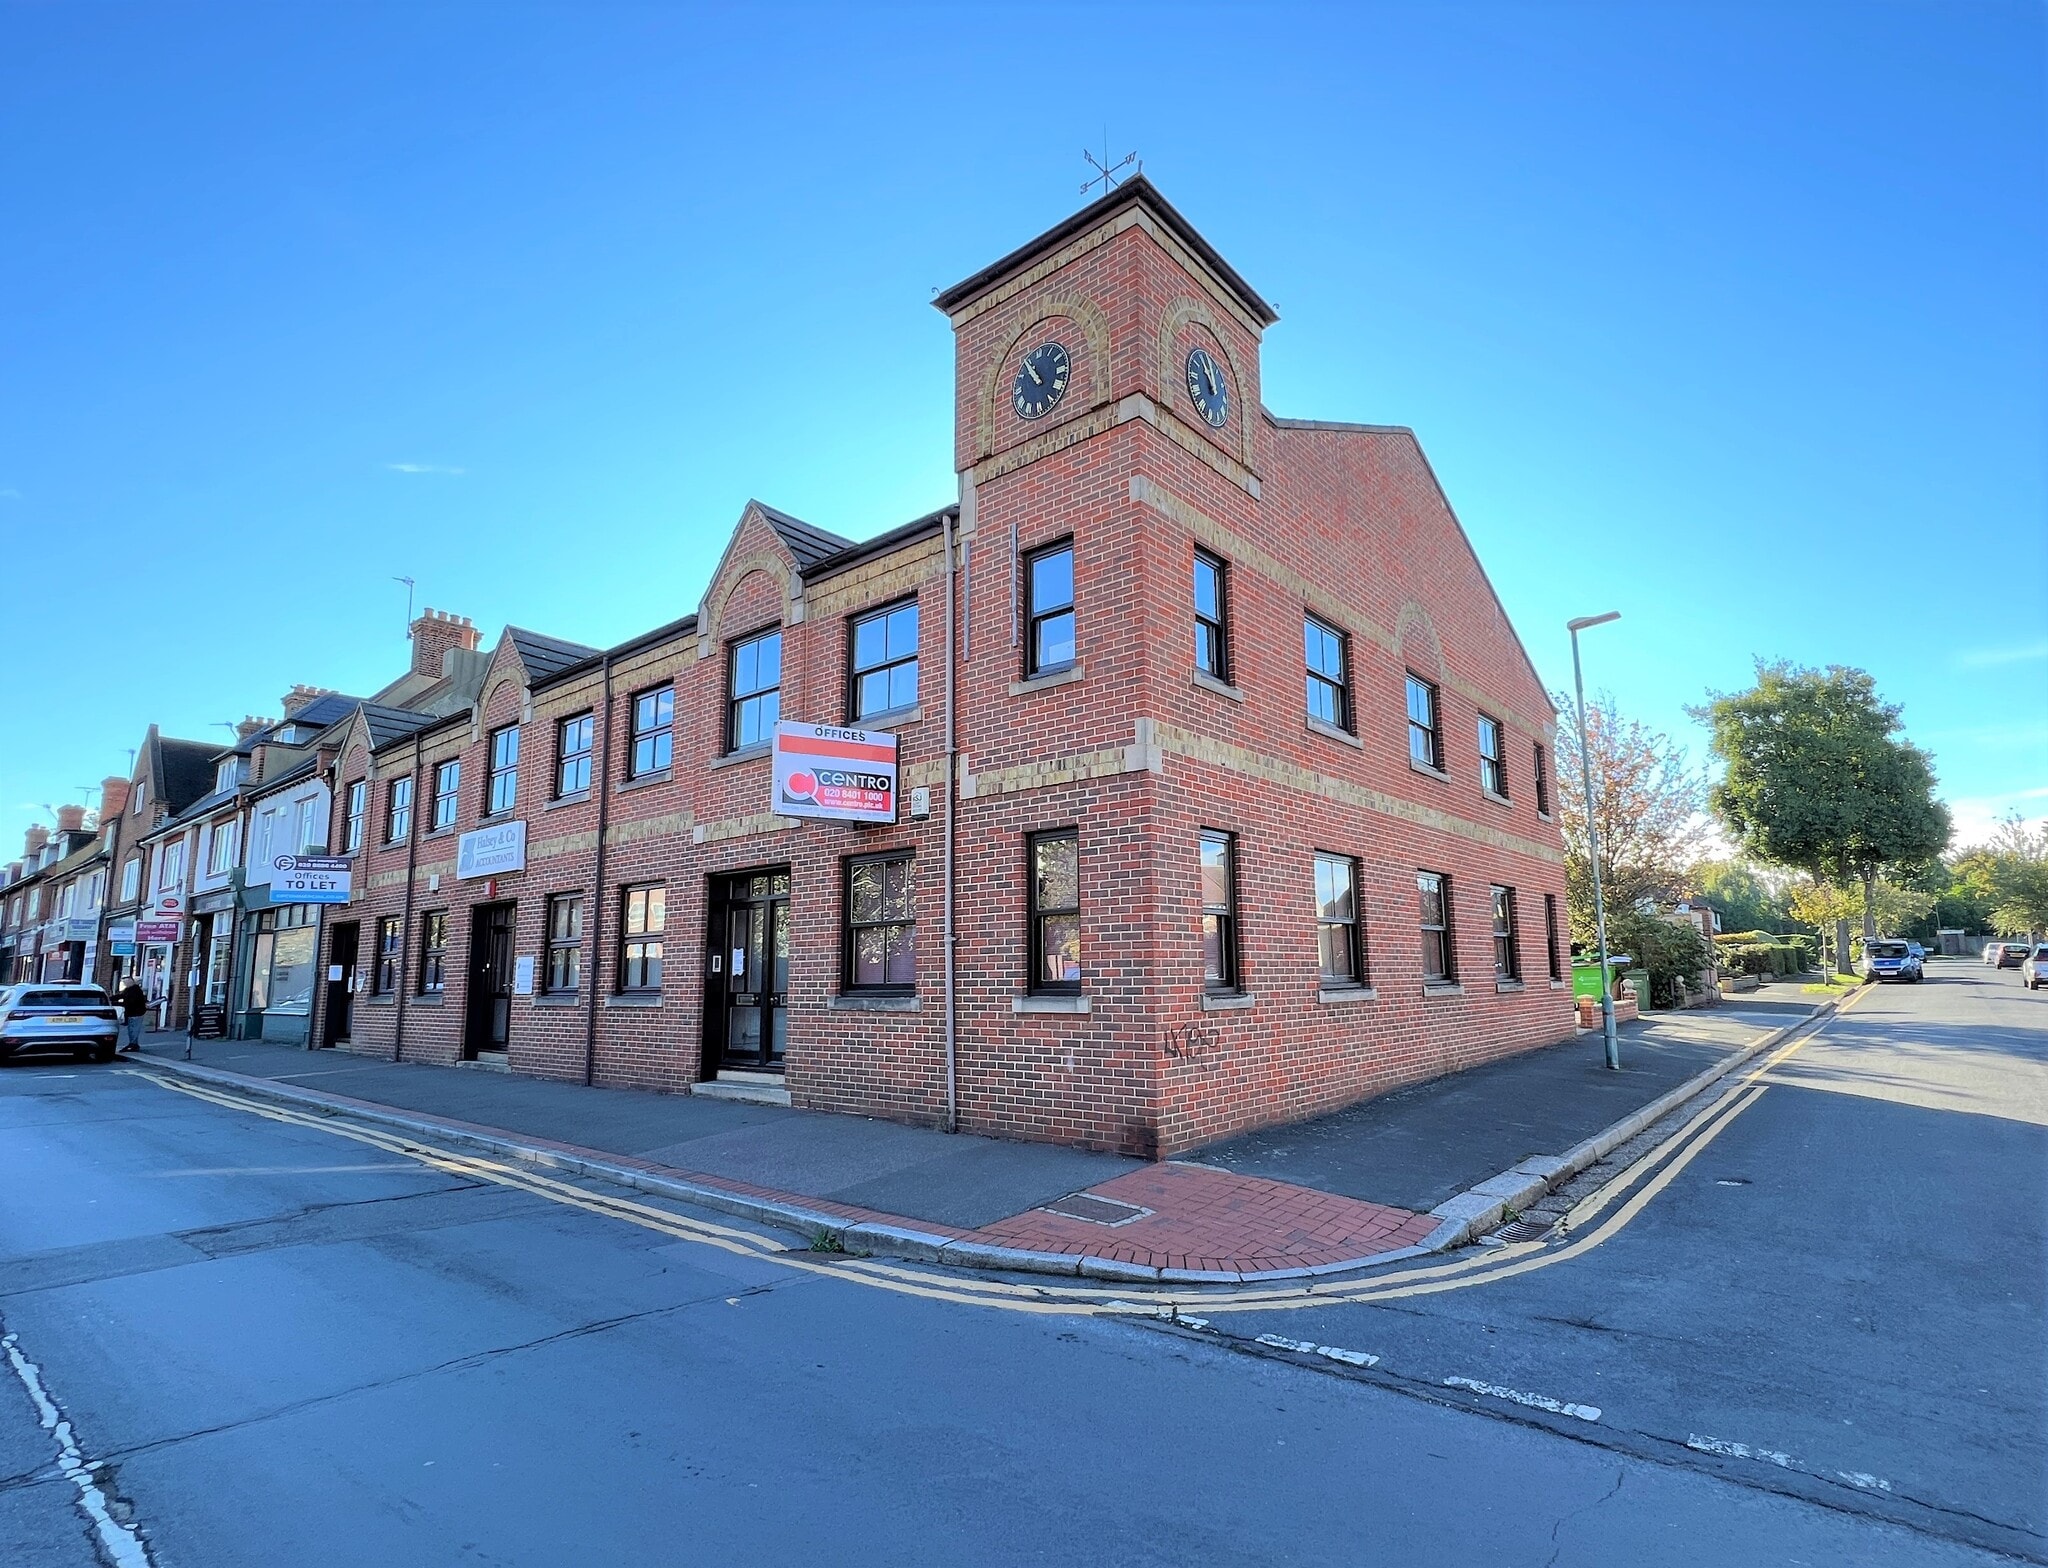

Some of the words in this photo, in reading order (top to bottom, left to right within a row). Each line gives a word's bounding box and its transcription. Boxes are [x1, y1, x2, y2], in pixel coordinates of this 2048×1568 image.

[815, 727, 866, 742] OFFICES
[824, 787, 840, 798] 020
[841, 789, 861, 800] 8401
[864, 791, 883, 801] 1000
[477, 835, 498, 849] Halsey
[498, 831, 505, 844] &
[505, 829, 516, 843] Co
[294, 872, 330, 880] Offices
[285, 880, 305, 889] TO
[310, 881, 337, 890] LET
